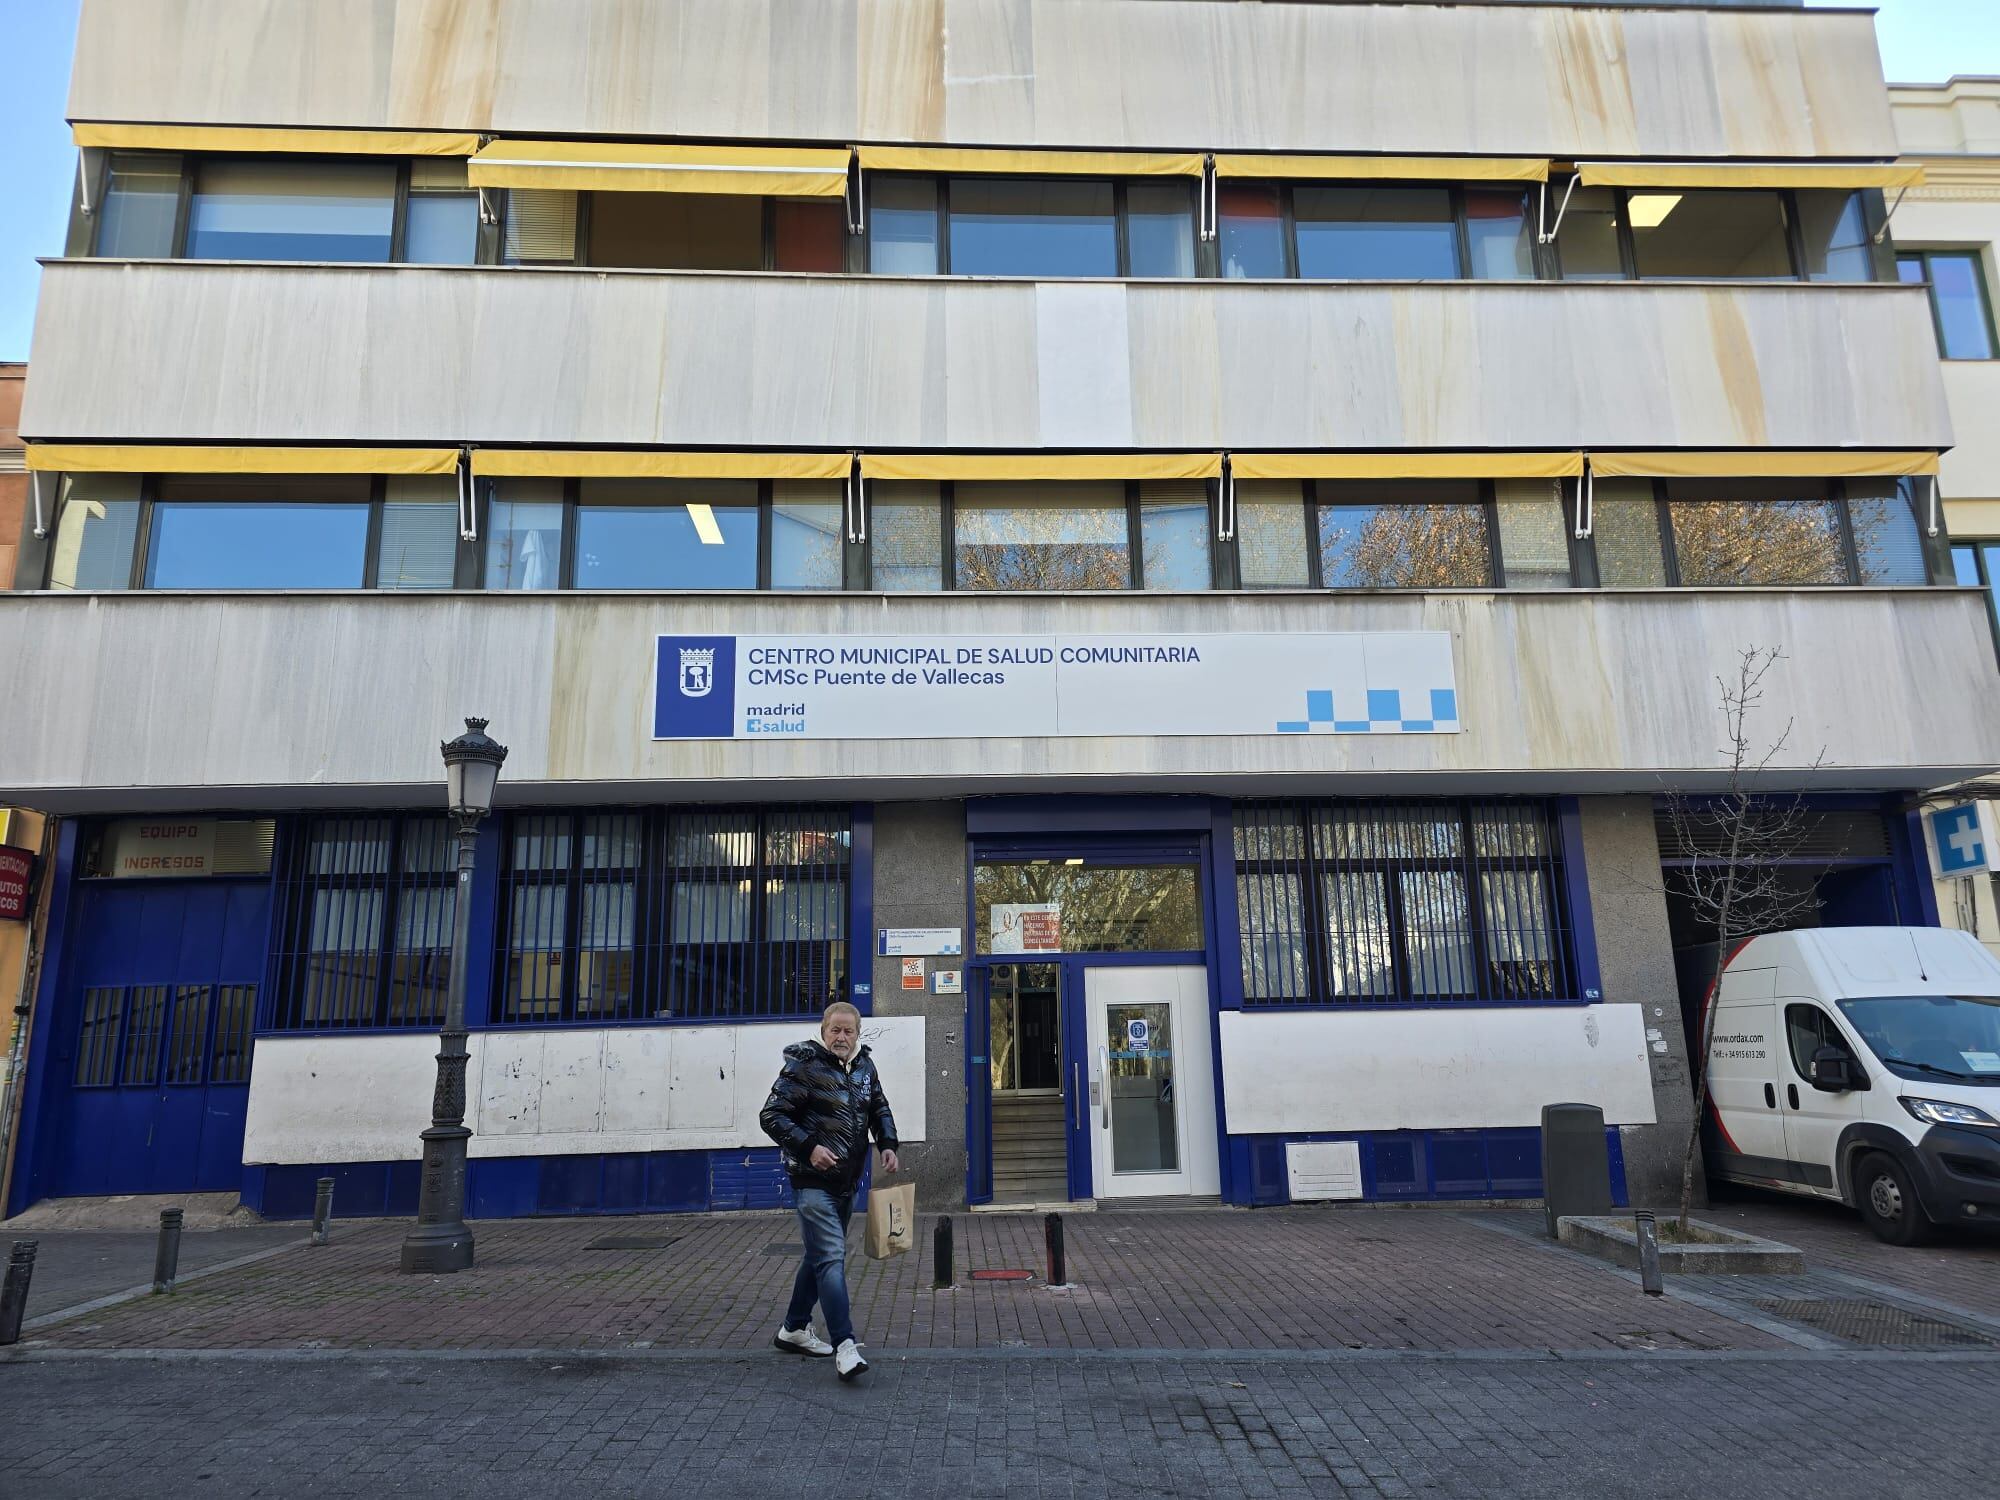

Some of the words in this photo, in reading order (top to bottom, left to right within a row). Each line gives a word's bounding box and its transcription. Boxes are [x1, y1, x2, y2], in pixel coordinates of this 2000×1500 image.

[748, 648, 835, 665] CENTRO
[840, 648, 951, 665] MUNICIPAL
[957, 648, 983, 664] DE
[988, 648, 1053, 664] SALUD
[1060, 647, 1201, 663] COMUNITARIA
[748, 668, 808, 685] CMSc
[814, 668, 886, 685] Puente
[891, 668, 917, 685] de
[922, 668, 1005, 685] Vallecas
[747, 703, 805, 716] madrid
[763, 719, 805, 733] salud
[141, 825, 198, 840] EQUIPO
[124, 856, 204, 870] INGRESOS
[0, 896, 19, 911] COS
[1713, 1032, 1764, 1043] www.ordax.com
